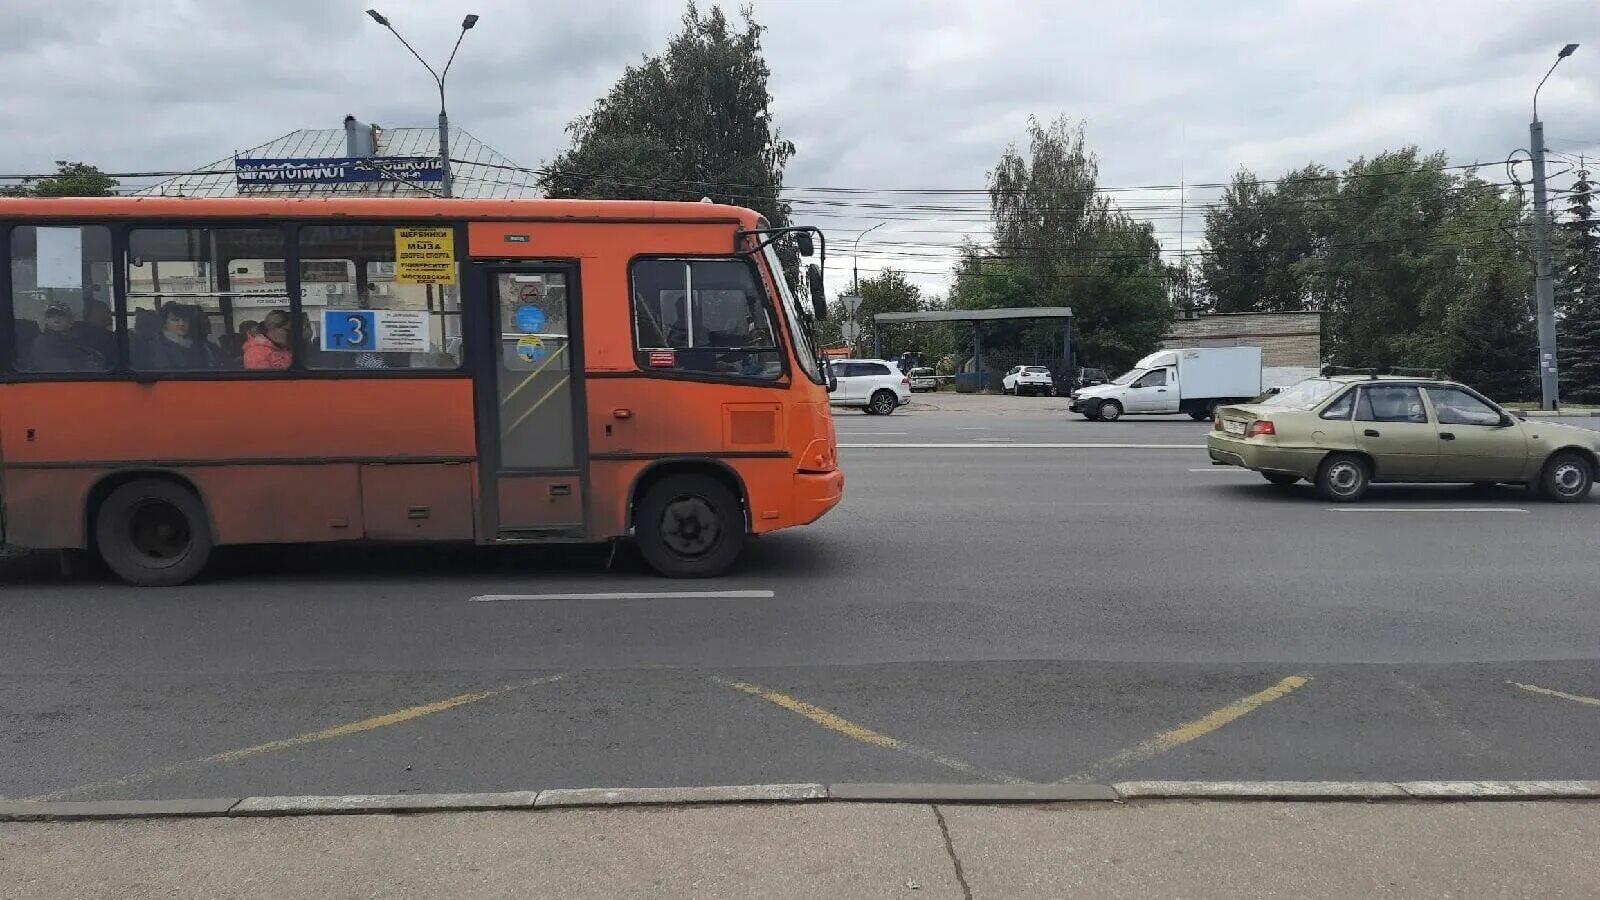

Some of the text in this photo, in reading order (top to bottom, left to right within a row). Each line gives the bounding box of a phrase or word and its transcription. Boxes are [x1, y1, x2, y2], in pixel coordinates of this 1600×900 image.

[353, 159, 442, 171] АОШКОЛА
[401, 273, 451, 281] МОСКОВСКИЙ
[347, 316, 365, 345] 3
